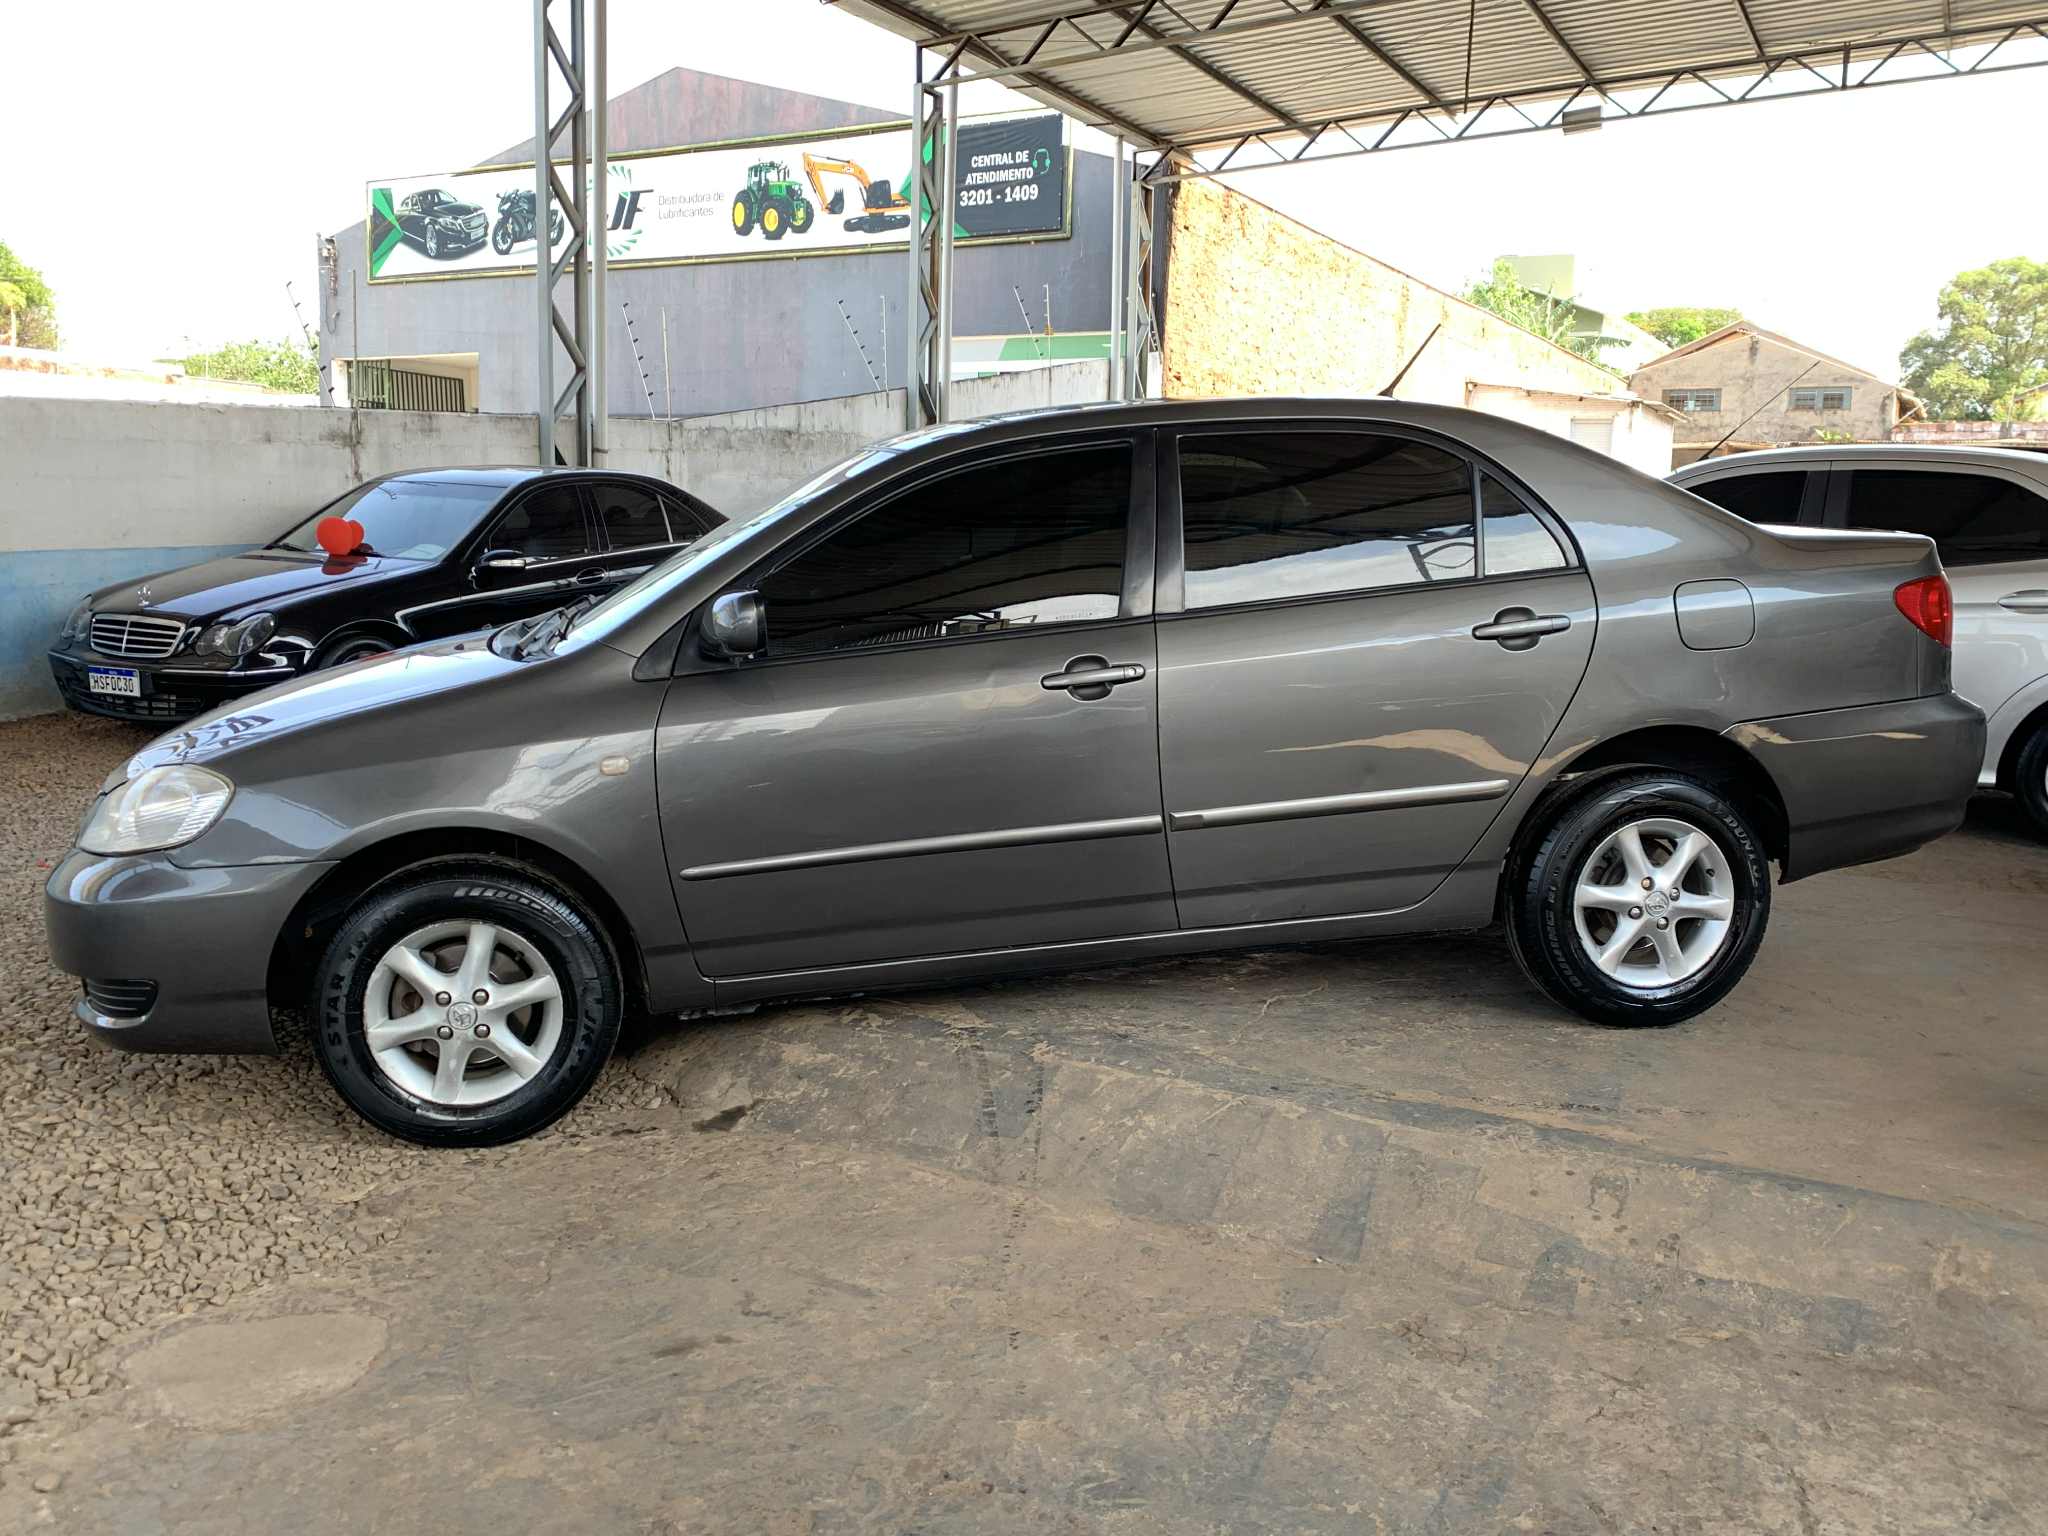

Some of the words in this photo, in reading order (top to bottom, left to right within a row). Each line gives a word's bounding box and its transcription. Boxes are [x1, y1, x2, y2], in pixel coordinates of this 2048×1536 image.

[971, 151, 1014, 168] CENTRAL
[1015, 150, 1029, 163] DE
[965, 167, 1033, 185] ATENDIMENTO
[658, 193, 711, 206] Distribuidora
[712, 191, 725, 201] de
[959, 188, 994, 207] 3201
[1004, 183, 1039, 203] 1409
[658, 206, 714, 220] Lubrificantes
